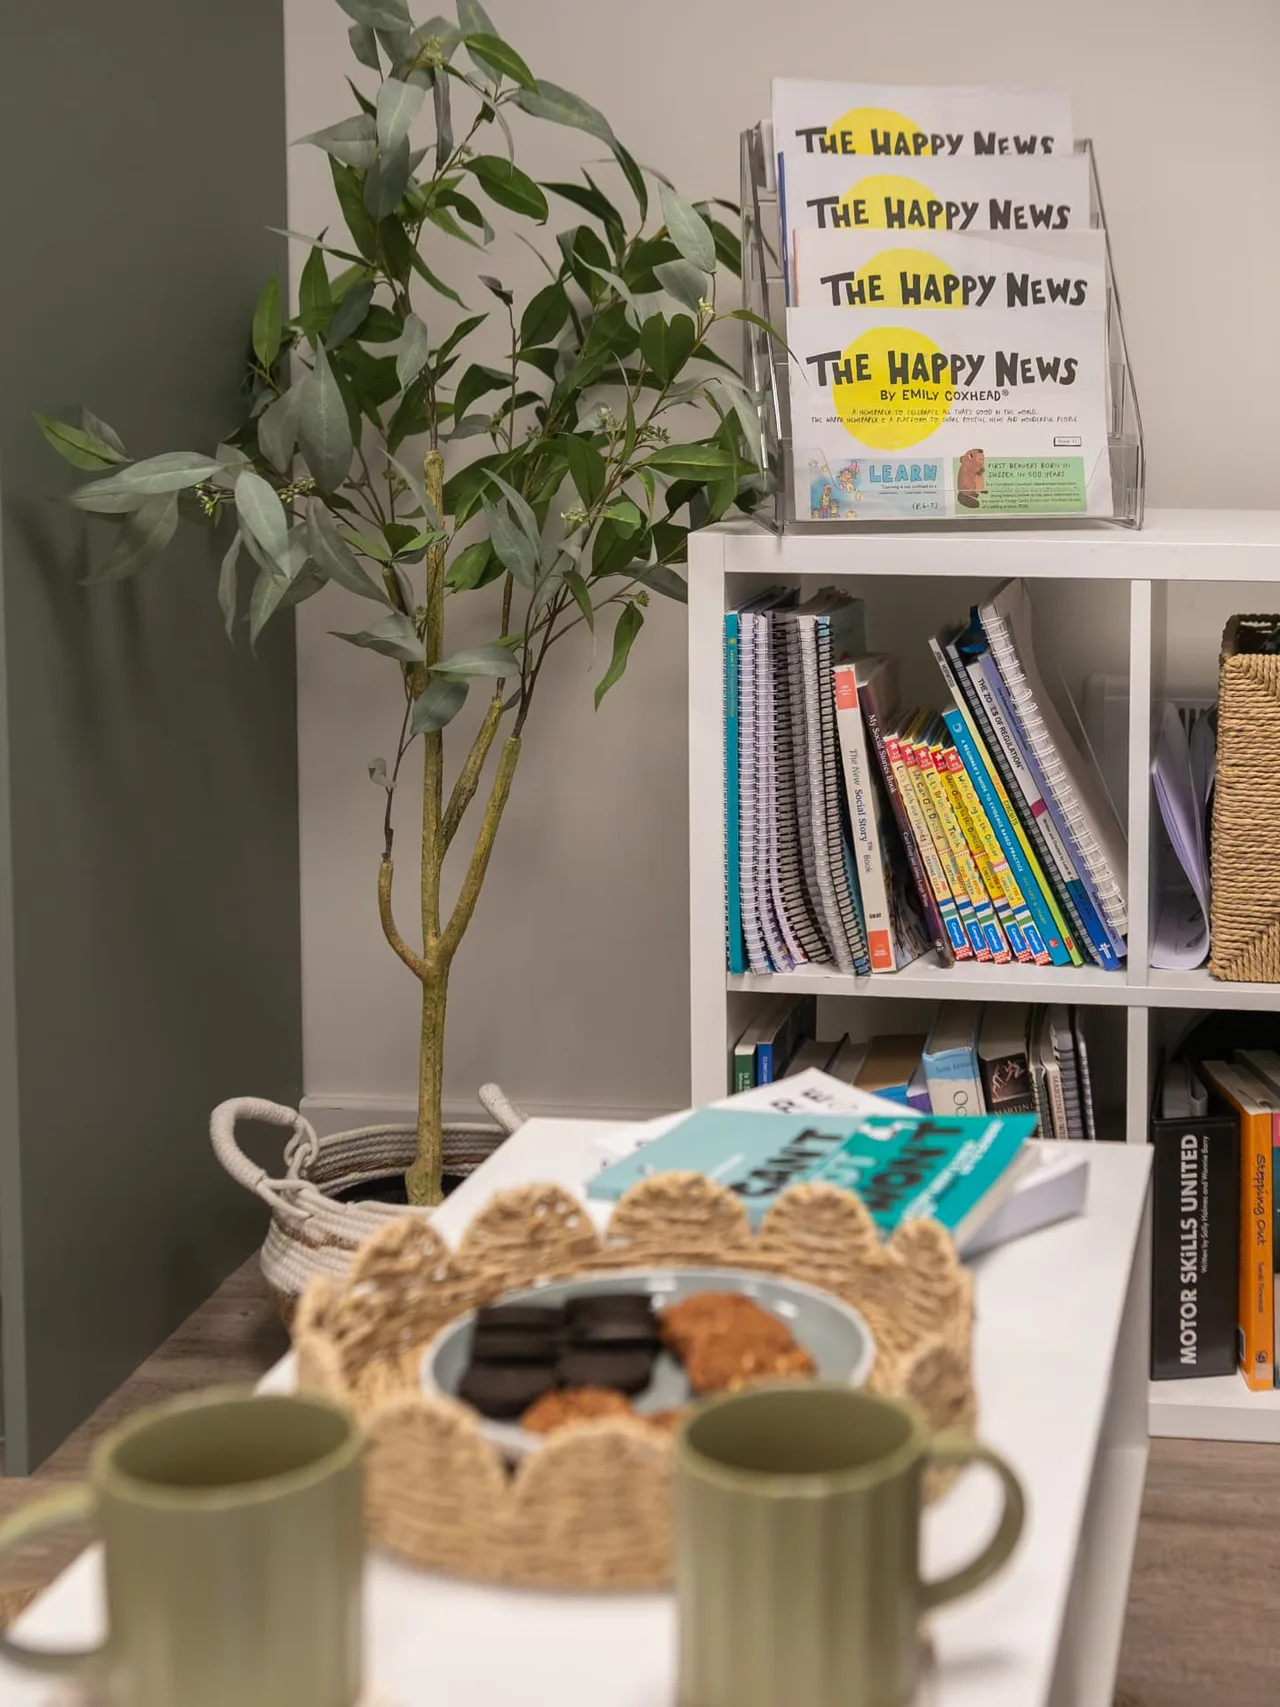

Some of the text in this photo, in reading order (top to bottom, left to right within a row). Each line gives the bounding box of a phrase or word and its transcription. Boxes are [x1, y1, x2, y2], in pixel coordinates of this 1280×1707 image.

[795, 126, 1055, 156] THE HAPPY NEWS
[806, 195, 1071, 231] THE HAPPY NEWS
[820, 271, 1088, 308] THE HAPPY NEWS
[805, 350, 1078, 387] THE HAPPY NEWS
[880, 389, 896, 402] BY
[902, 389, 940, 402] EMILY
[868, 463, 938, 483] LEARN
[977, 678, 988, 692] THE
[983, 692, 999, 717] ZOES
[994, 716, 1004, 727] OF
[866, 714, 878, 728] My
[871, 727, 885, 750] Social
[849, 748, 859, 764] The
[877, 749, 893, 775] Stories
[852, 766, 862, 785] New
[885, 775, 898, 794] Book
[977, 775, 988, 792] GUIDE
[855, 789, 866, 816] Social
[985, 793, 992, 802] TO
[988, 802, 1004, 828] EVIDENCE
[1000, 828, 1012, 847] BASED
[863, 854, 873, 873] Book
[1009, 846, 1024, 872] PRACTICE
[1180, 1134, 1198, 1212] UNITED
[1253, 1154, 1268, 1246] Stepping Out
[1201, 1222, 1209, 1238] Sally
[1202, 1240, 1209, 1248] by
[1180, 1288, 1198, 1365] MOTOR
